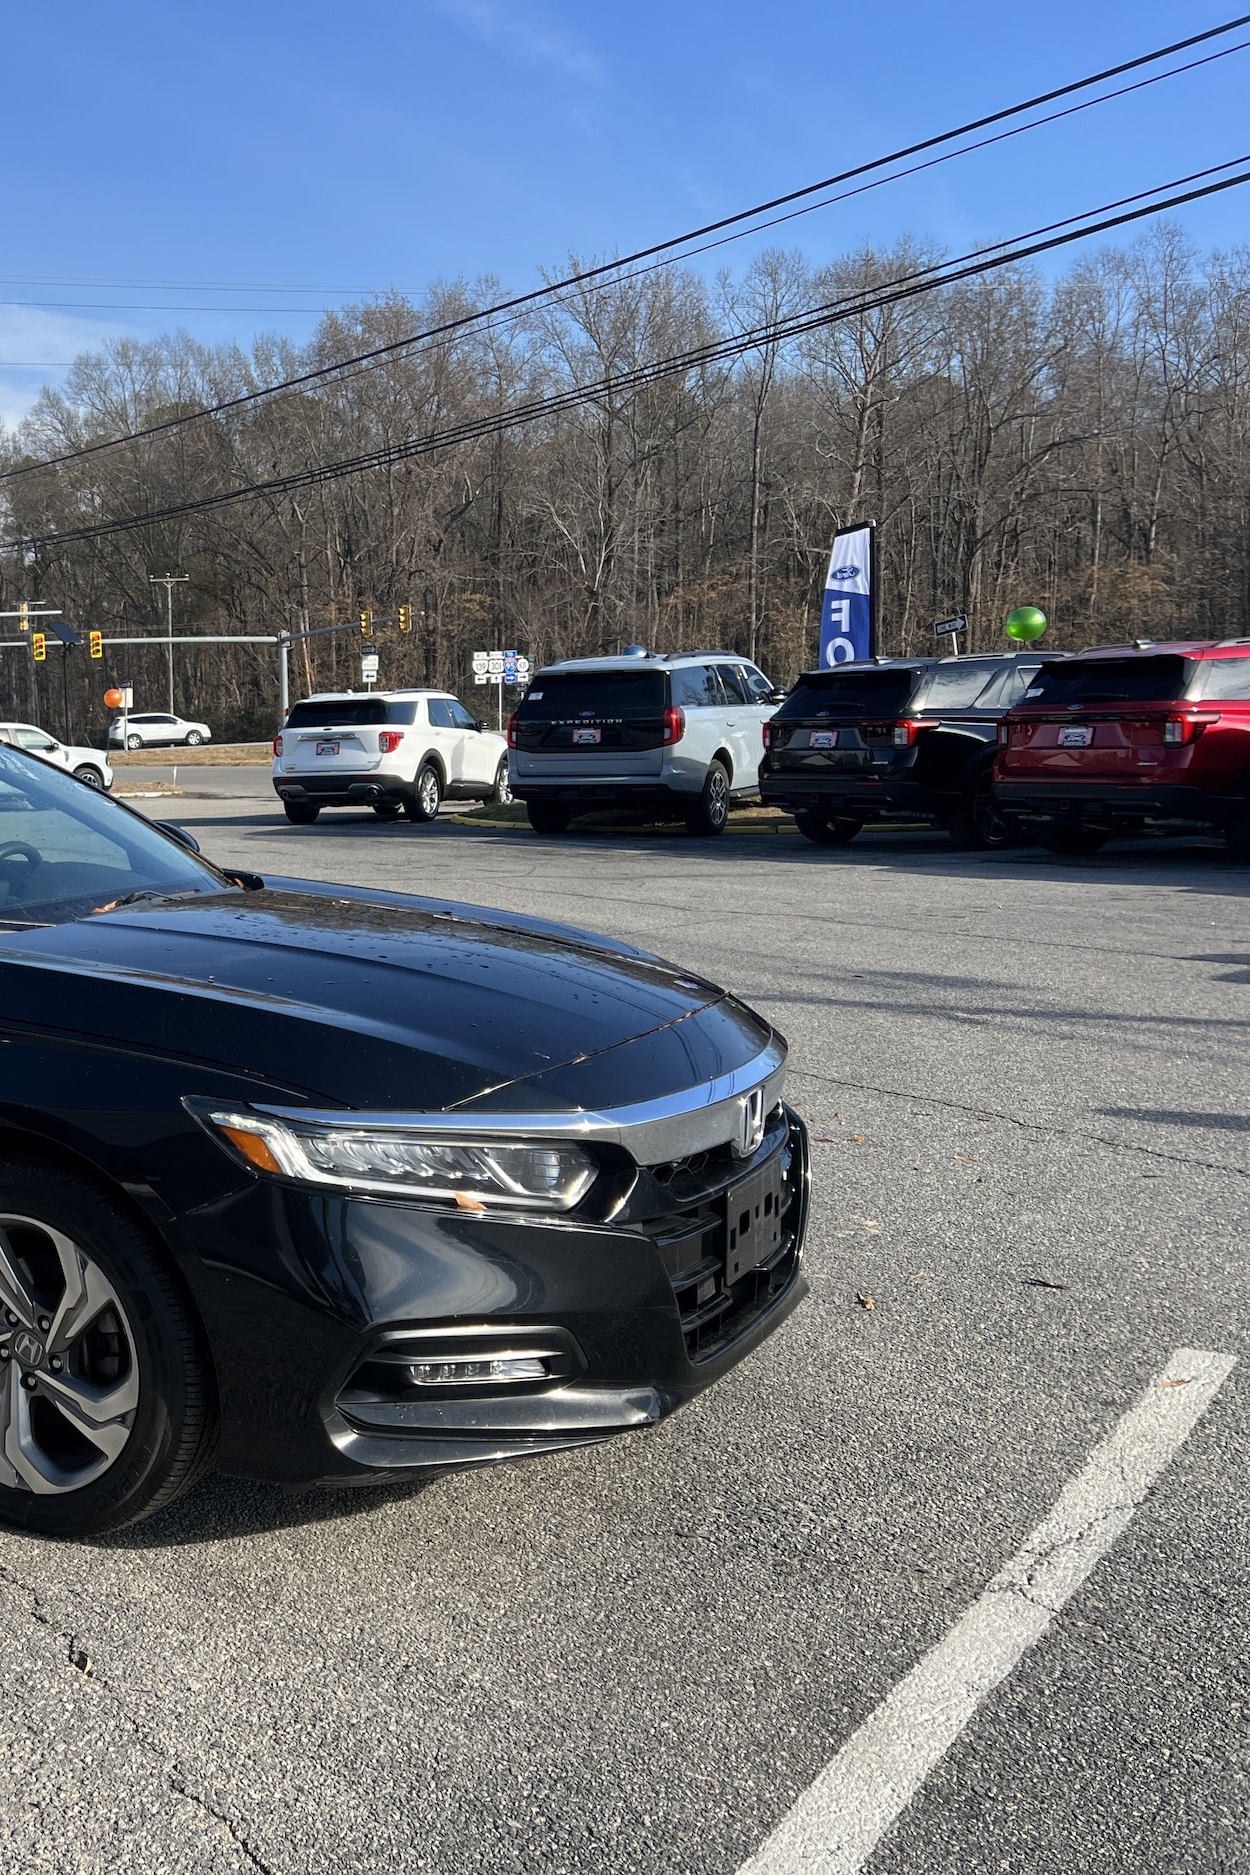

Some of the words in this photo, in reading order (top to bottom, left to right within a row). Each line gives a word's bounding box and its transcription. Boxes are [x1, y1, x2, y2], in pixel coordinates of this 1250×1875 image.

[475, 662, 486, 671] 139
[490, 662, 502, 671] 301
[505, 663, 515, 671] 95
